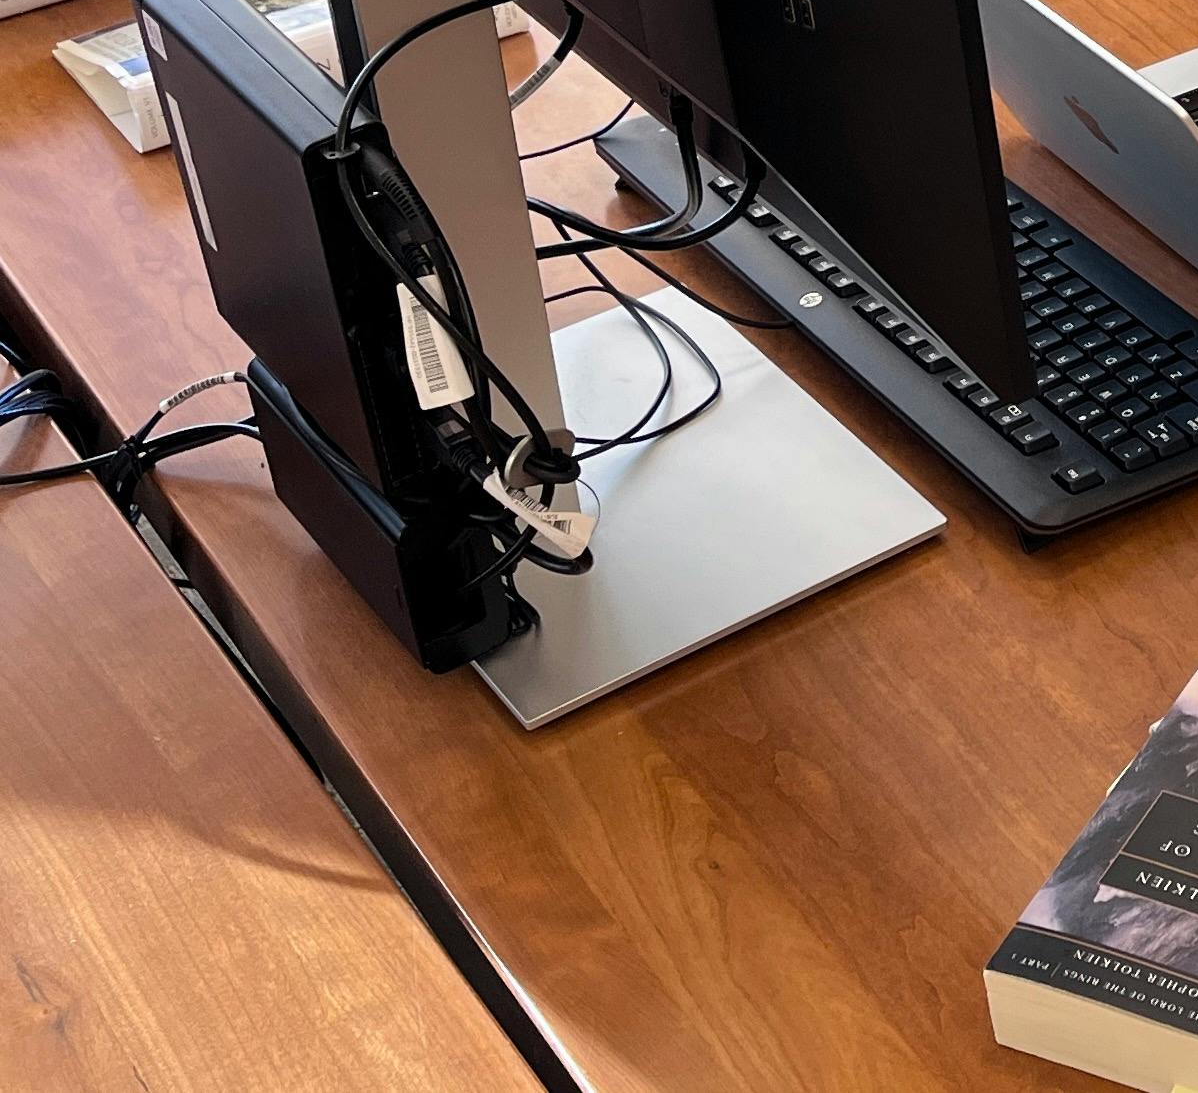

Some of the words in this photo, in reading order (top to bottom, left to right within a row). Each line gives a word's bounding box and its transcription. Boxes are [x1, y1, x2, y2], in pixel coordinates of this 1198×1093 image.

[1160, 840, 1191, 857] OF
[1020, 957, 1050, 971] PART
[1073, 949, 1141, 979] TOLKIEN
[1063, 969, 1100, 986] RINGS
[1103, 982, 1126, 996] THE
[1128, 990, 1146, 1002] OF
[1150, 997, 1184, 1015] LORD
